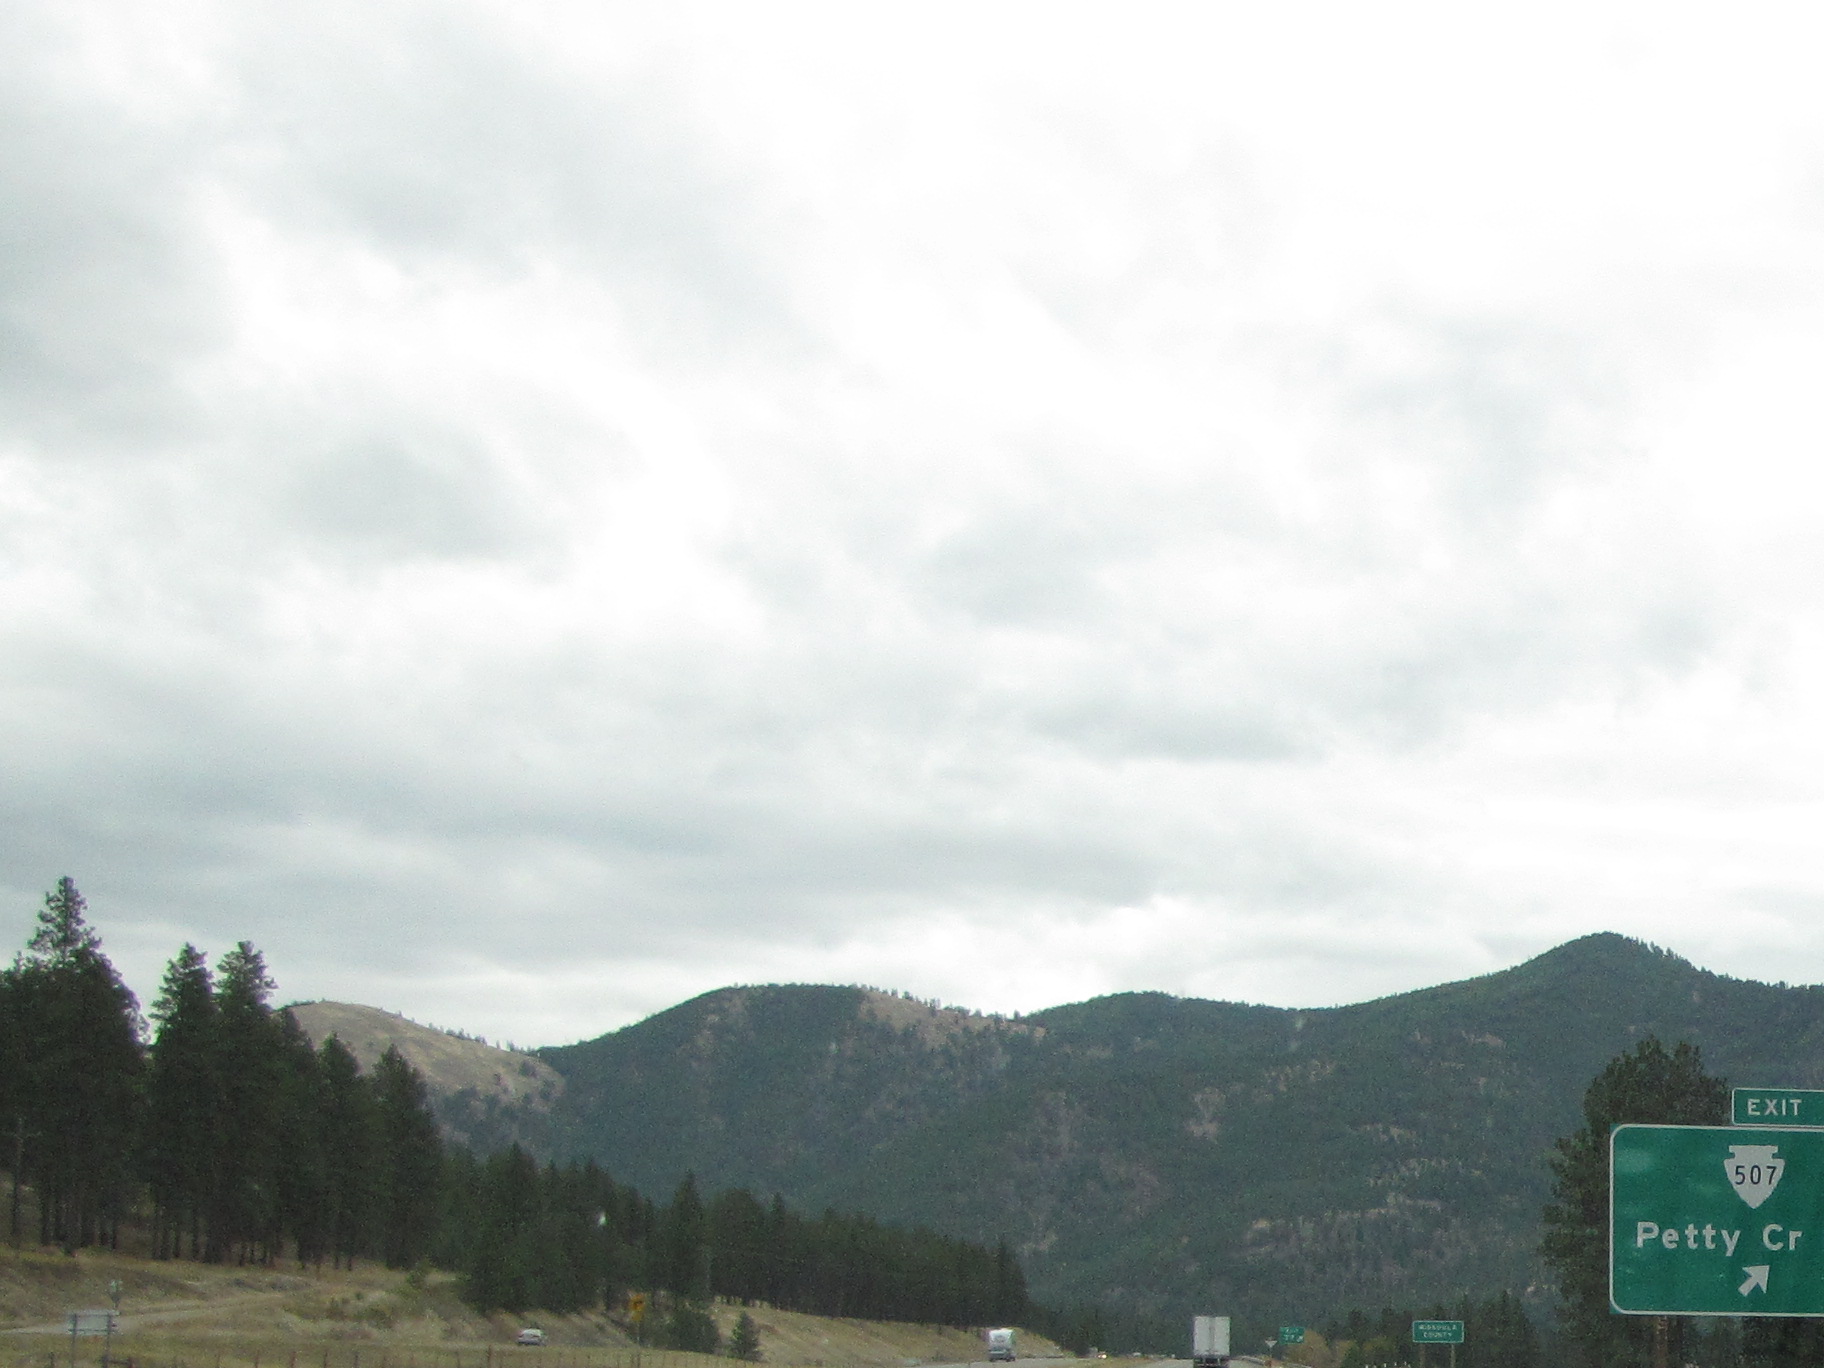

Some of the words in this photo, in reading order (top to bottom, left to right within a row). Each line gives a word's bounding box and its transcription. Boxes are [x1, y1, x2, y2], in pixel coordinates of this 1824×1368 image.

[1747, 1099, 1802, 1116] EXIT
[1734, 1165, 1778, 1186] 507
[1636, 1221, 1741, 1257] Petty
[1762, 1223, 1803, 1252] Cr
